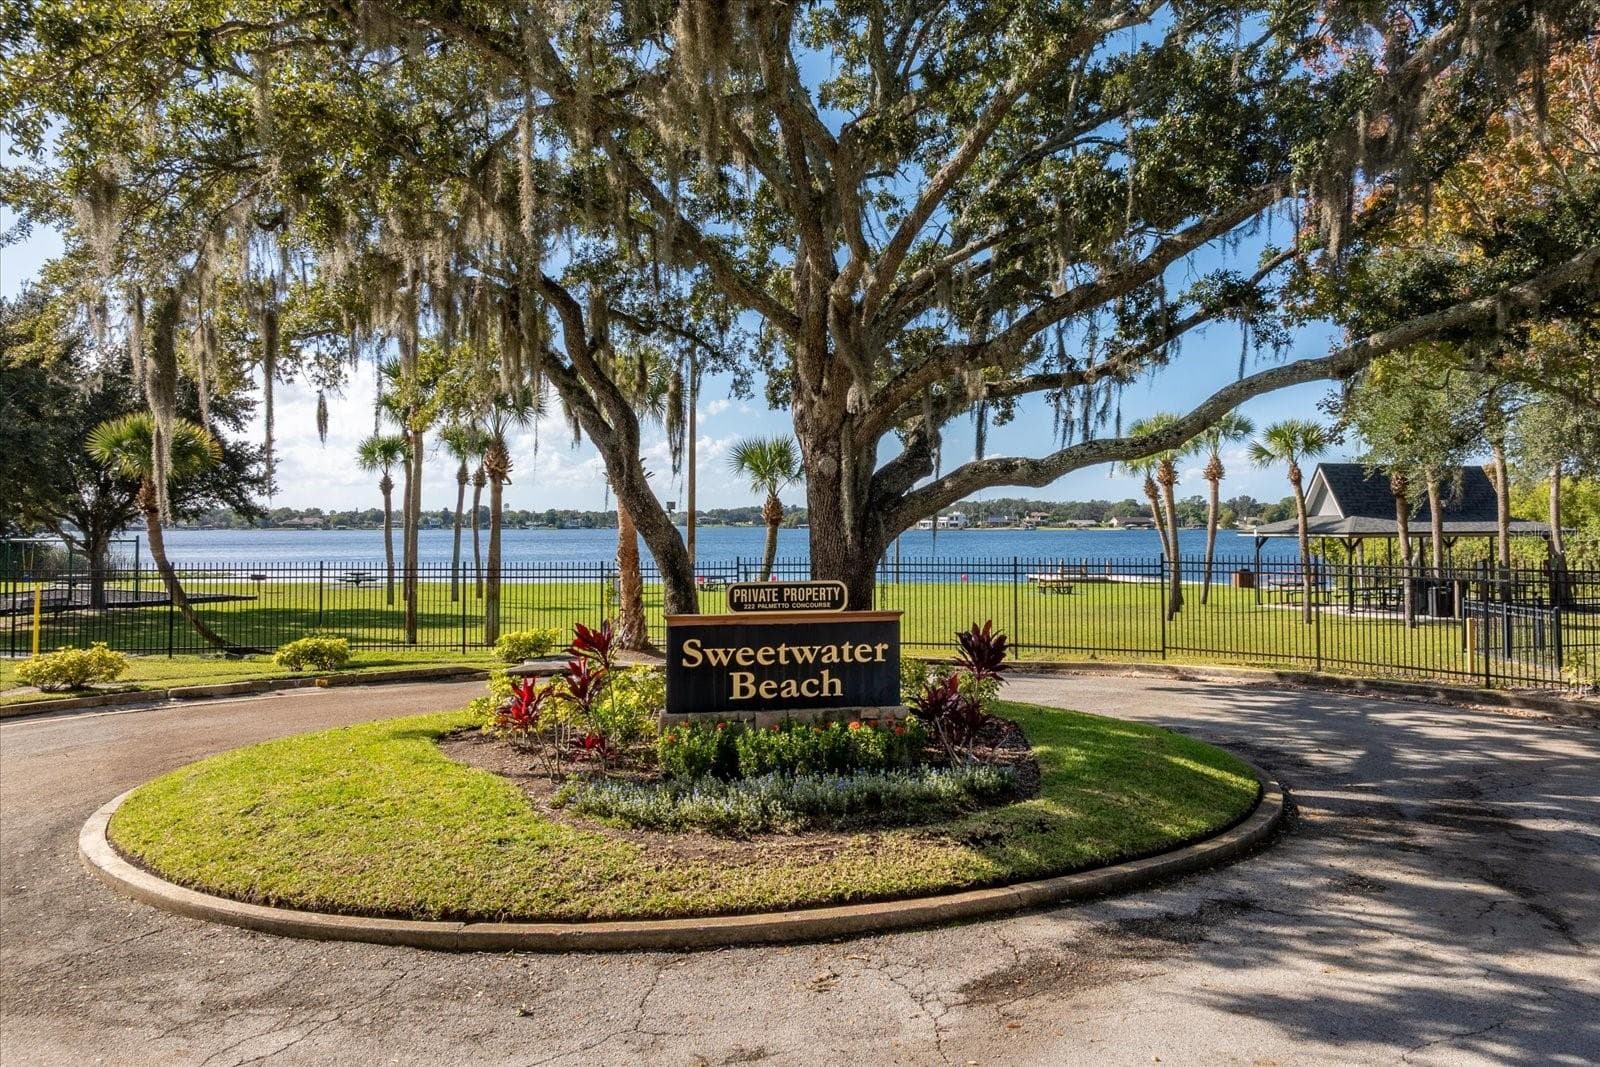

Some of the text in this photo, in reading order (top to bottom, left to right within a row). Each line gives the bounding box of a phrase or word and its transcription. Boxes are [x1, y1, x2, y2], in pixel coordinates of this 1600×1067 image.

[733, 587, 840, 602] PRIVATE PROPERTY
[791, 601, 831, 609] CONCOURSE
[682, 639, 889, 667] Sweetwater
[729, 669, 844, 700] Beach
